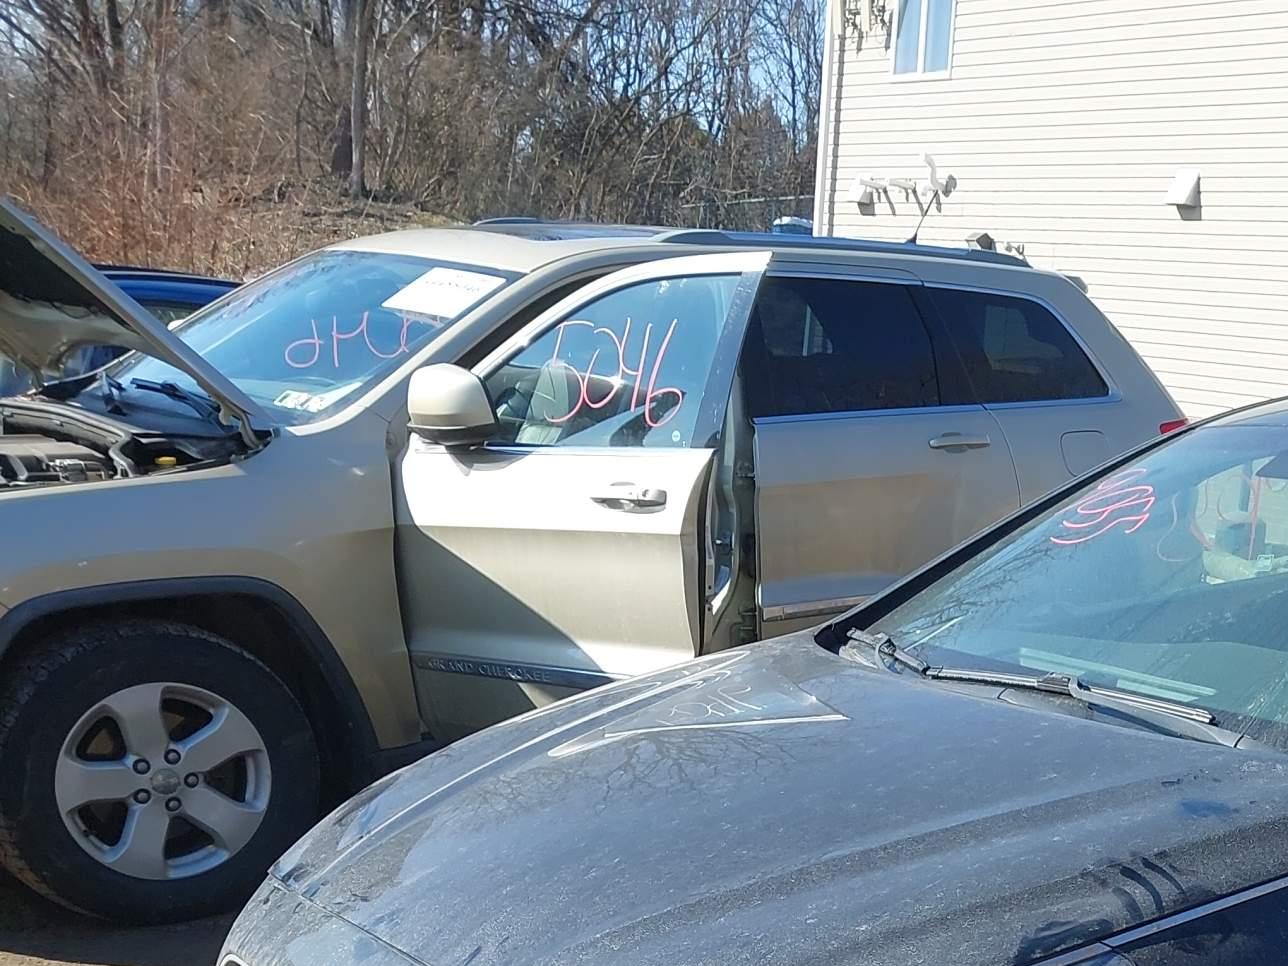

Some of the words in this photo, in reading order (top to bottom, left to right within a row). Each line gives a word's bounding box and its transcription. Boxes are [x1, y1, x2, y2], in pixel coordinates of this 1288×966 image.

[543, 316, 683, 427] 5046
[427, 656, 473, 674] GRAND
[477, 663, 552, 682] CHEROKEE
